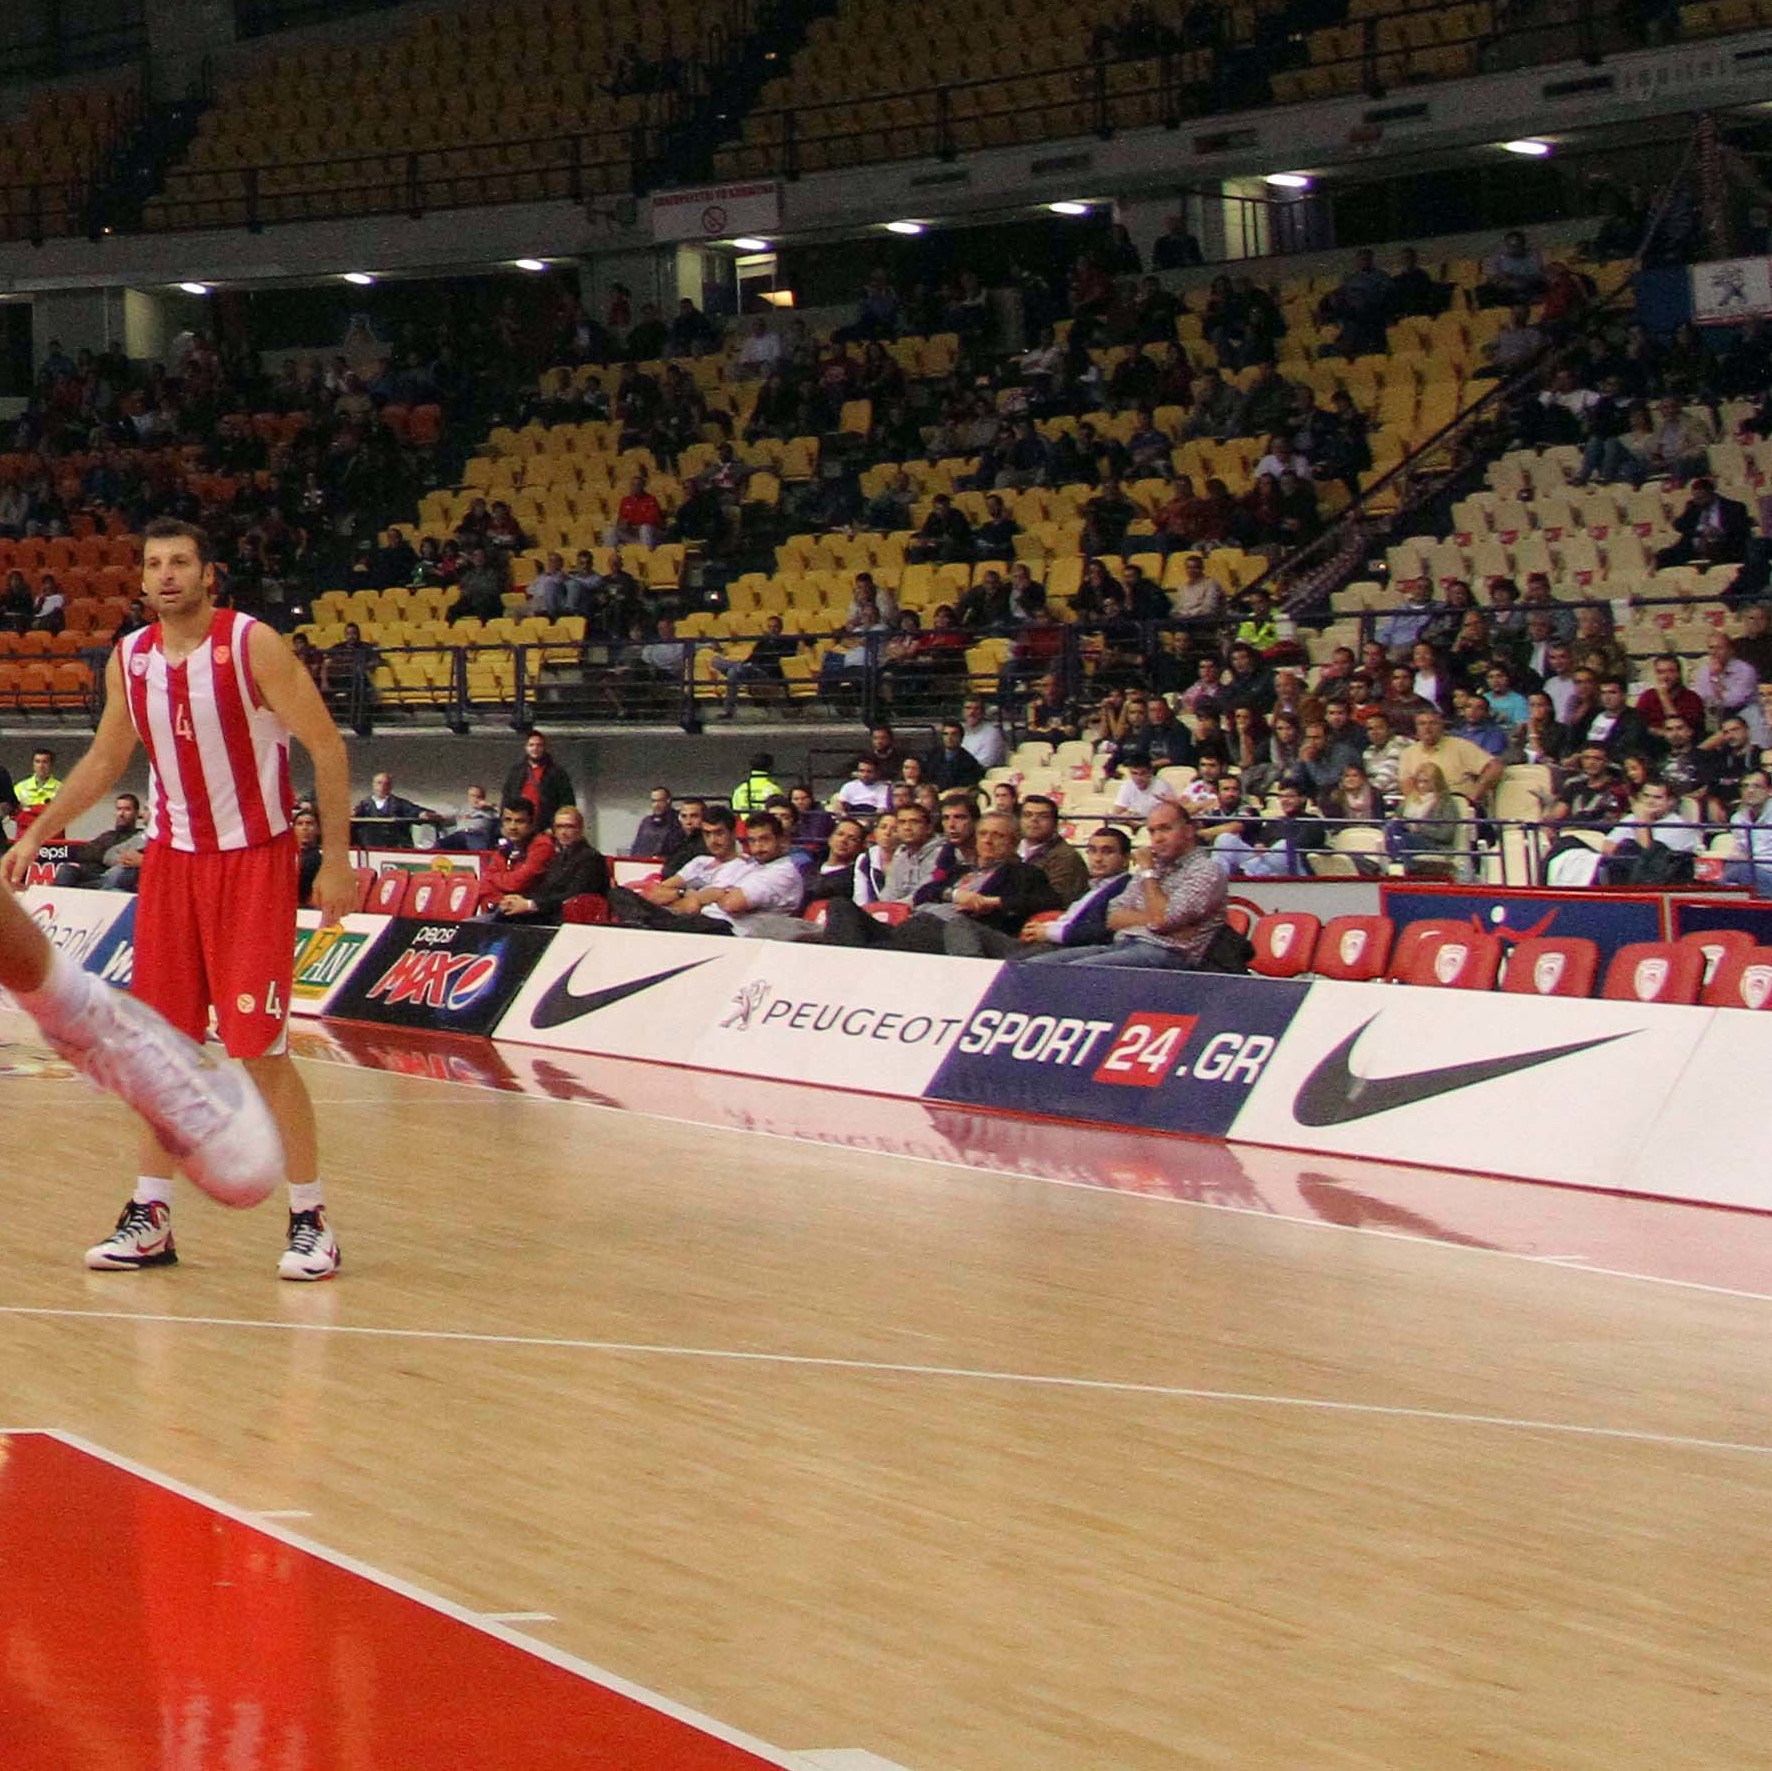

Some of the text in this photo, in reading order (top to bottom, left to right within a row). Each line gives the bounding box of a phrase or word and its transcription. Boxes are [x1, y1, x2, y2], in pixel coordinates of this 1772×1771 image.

[175, 703, 194, 742] 4
[39, 845, 69, 860] epsi
[412, 925, 457, 946] pepsi
[264, 979, 283, 1020] 4
[762, 997, 965, 1047] PEUGEOT
[958, 1007, 1275, 1085] SPORT 24 .GR
